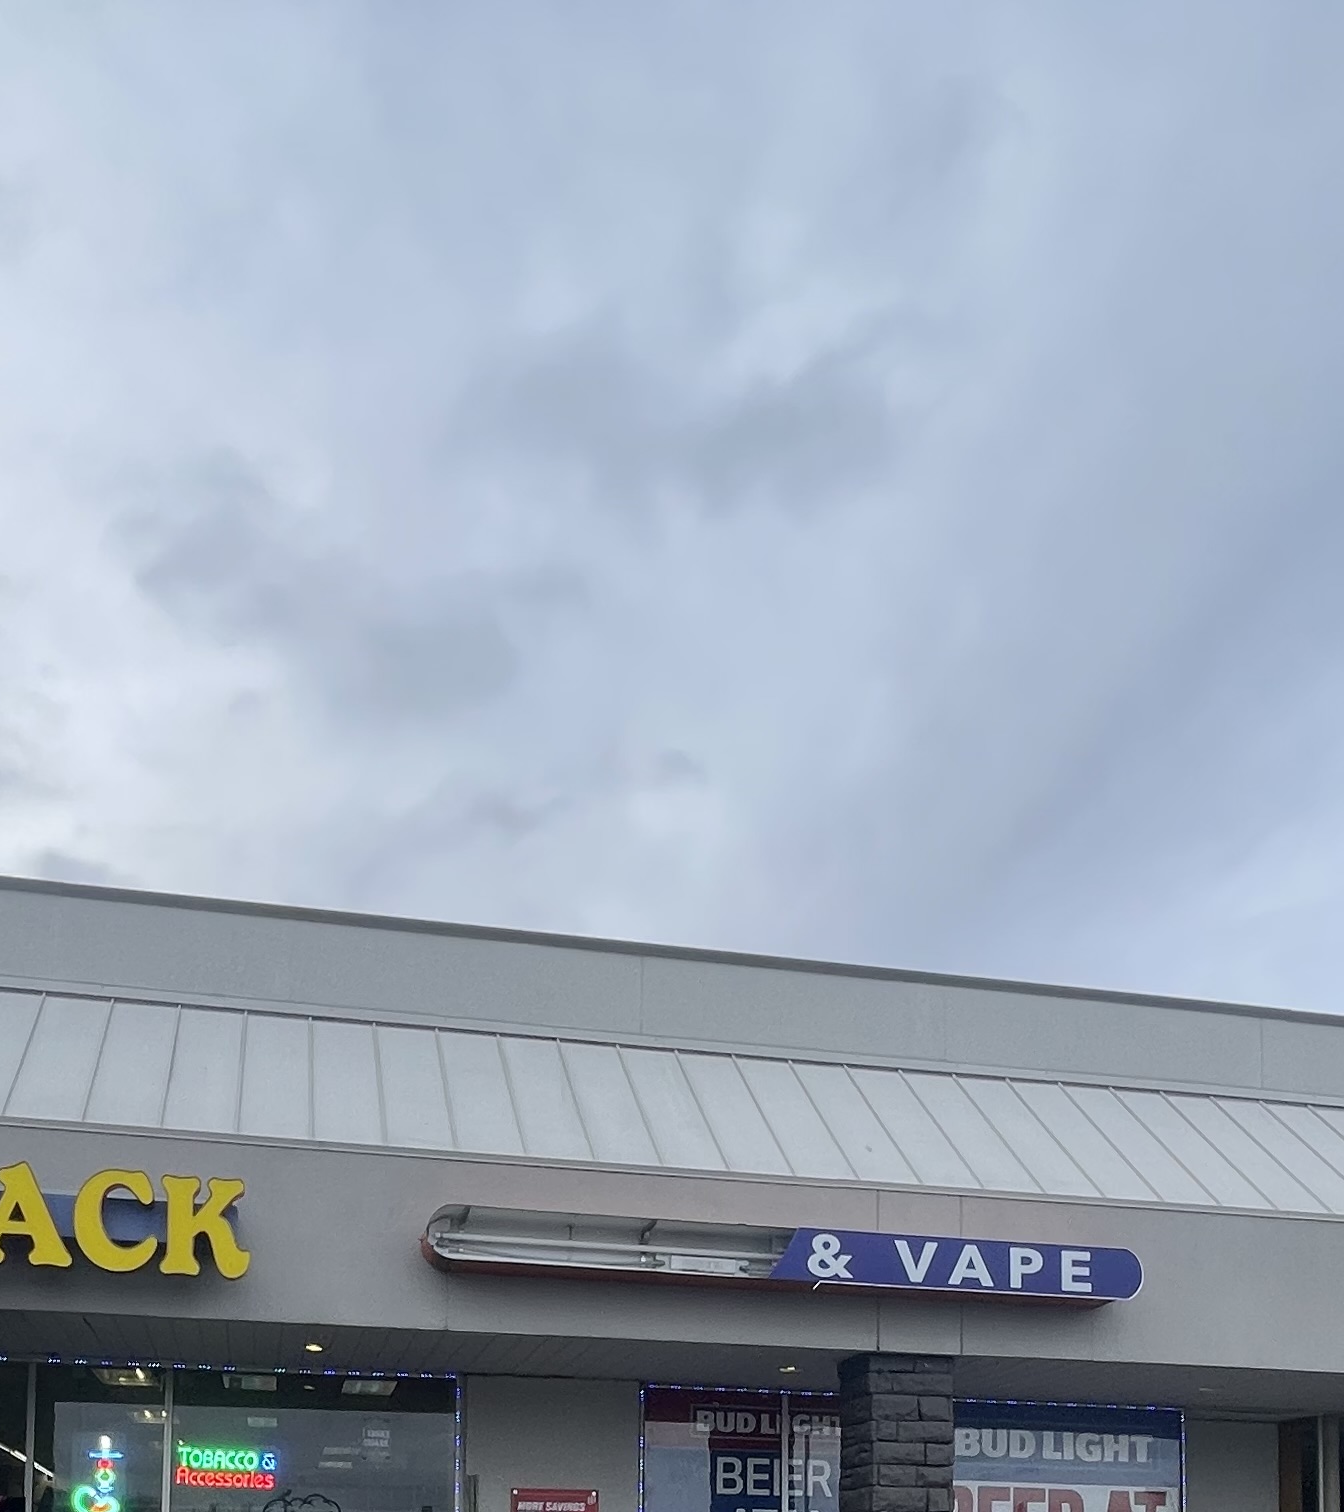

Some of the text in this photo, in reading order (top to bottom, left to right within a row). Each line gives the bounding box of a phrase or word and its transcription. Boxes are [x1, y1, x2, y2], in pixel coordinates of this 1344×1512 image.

[807, 1233, 1094, 1293] & VAPE
[697, 1410, 756, 1433] BUD
[177, 1447, 278, 1471] TOBACCO &
[954, 1428, 1153, 1463] BUD LIGHT
[175, 1467, 275, 1489] Accessories
[716, 1456, 832, 1497] BEER
